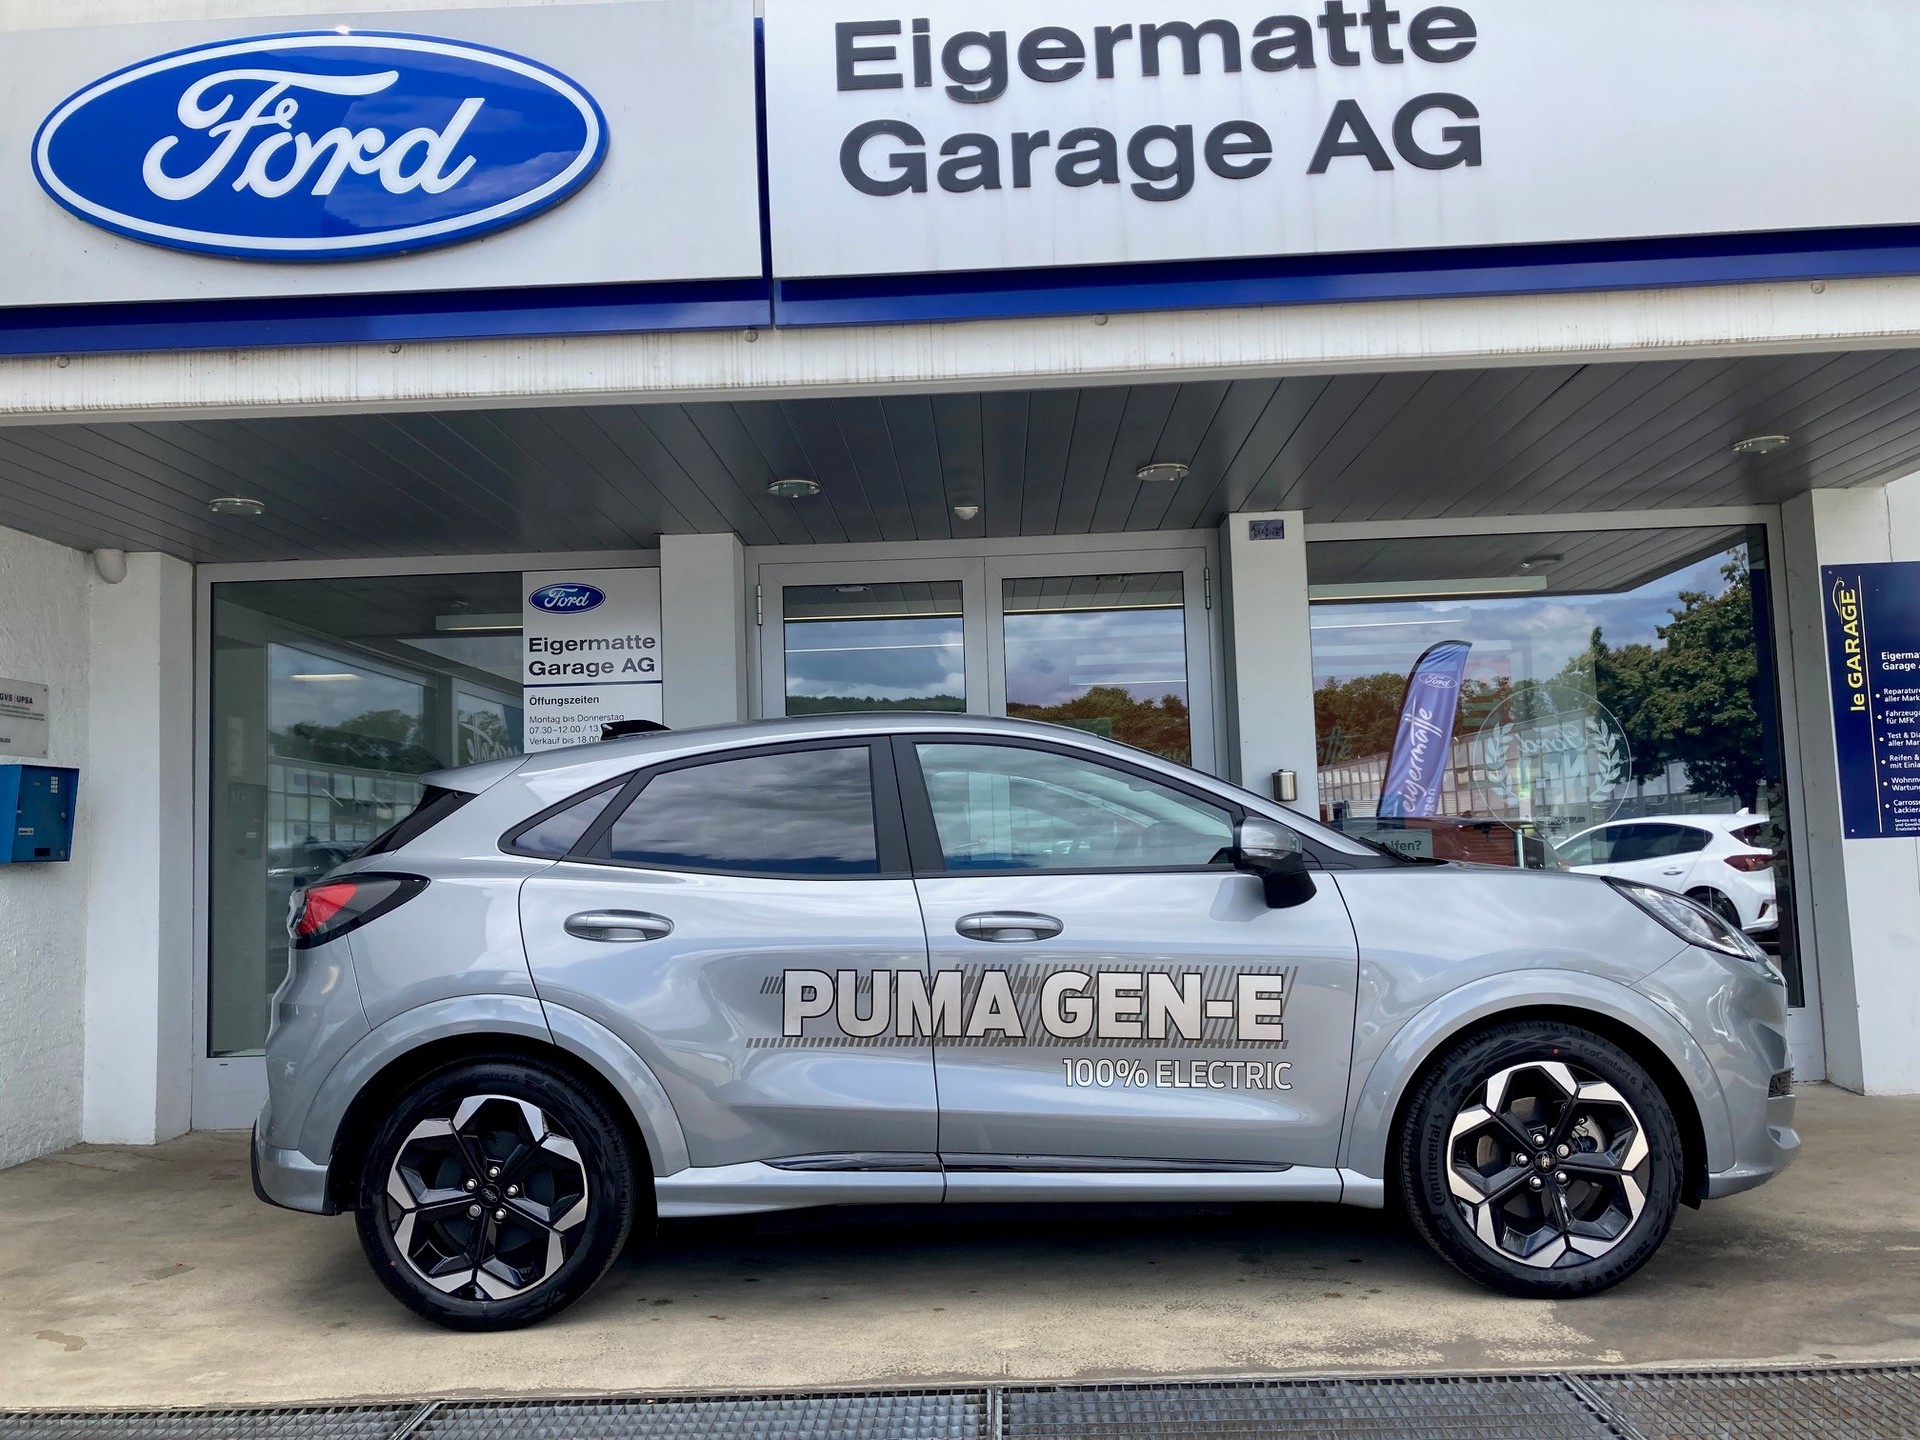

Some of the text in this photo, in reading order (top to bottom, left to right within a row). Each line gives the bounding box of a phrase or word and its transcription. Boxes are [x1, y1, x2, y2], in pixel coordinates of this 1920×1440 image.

[834, 0, 1478, 104] Eigermatte
[142, 69, 485, 201] Ford
[839, 92, 1482, 202] Garage AG
[544, 587, 589, 607] Ford
[528, 634, 656, 656] Eigermatte
[1840, 588, 1864, 689] GARAGE
[528, 656, 655, 678] Garage AG
[1425, 674, 1451, 687] Ford
[1882, 662, 1916, 671] Garage
[529, 694, 600, 707] Öffungszeiten
[529, 713, 625, 724] Montag bis Donnerstag
[529, 737, 560, 745] Verkauf
[562, 736, 575, 744] bis
[1397, 696, 1443, 814] eigermatte
[782, 969, 1285, 1041] PUMA GEN-E
[1062, 1057, 1293, 1091] 100% ELECTRIC
[1425, 1123, 1446, 1207] Continental
